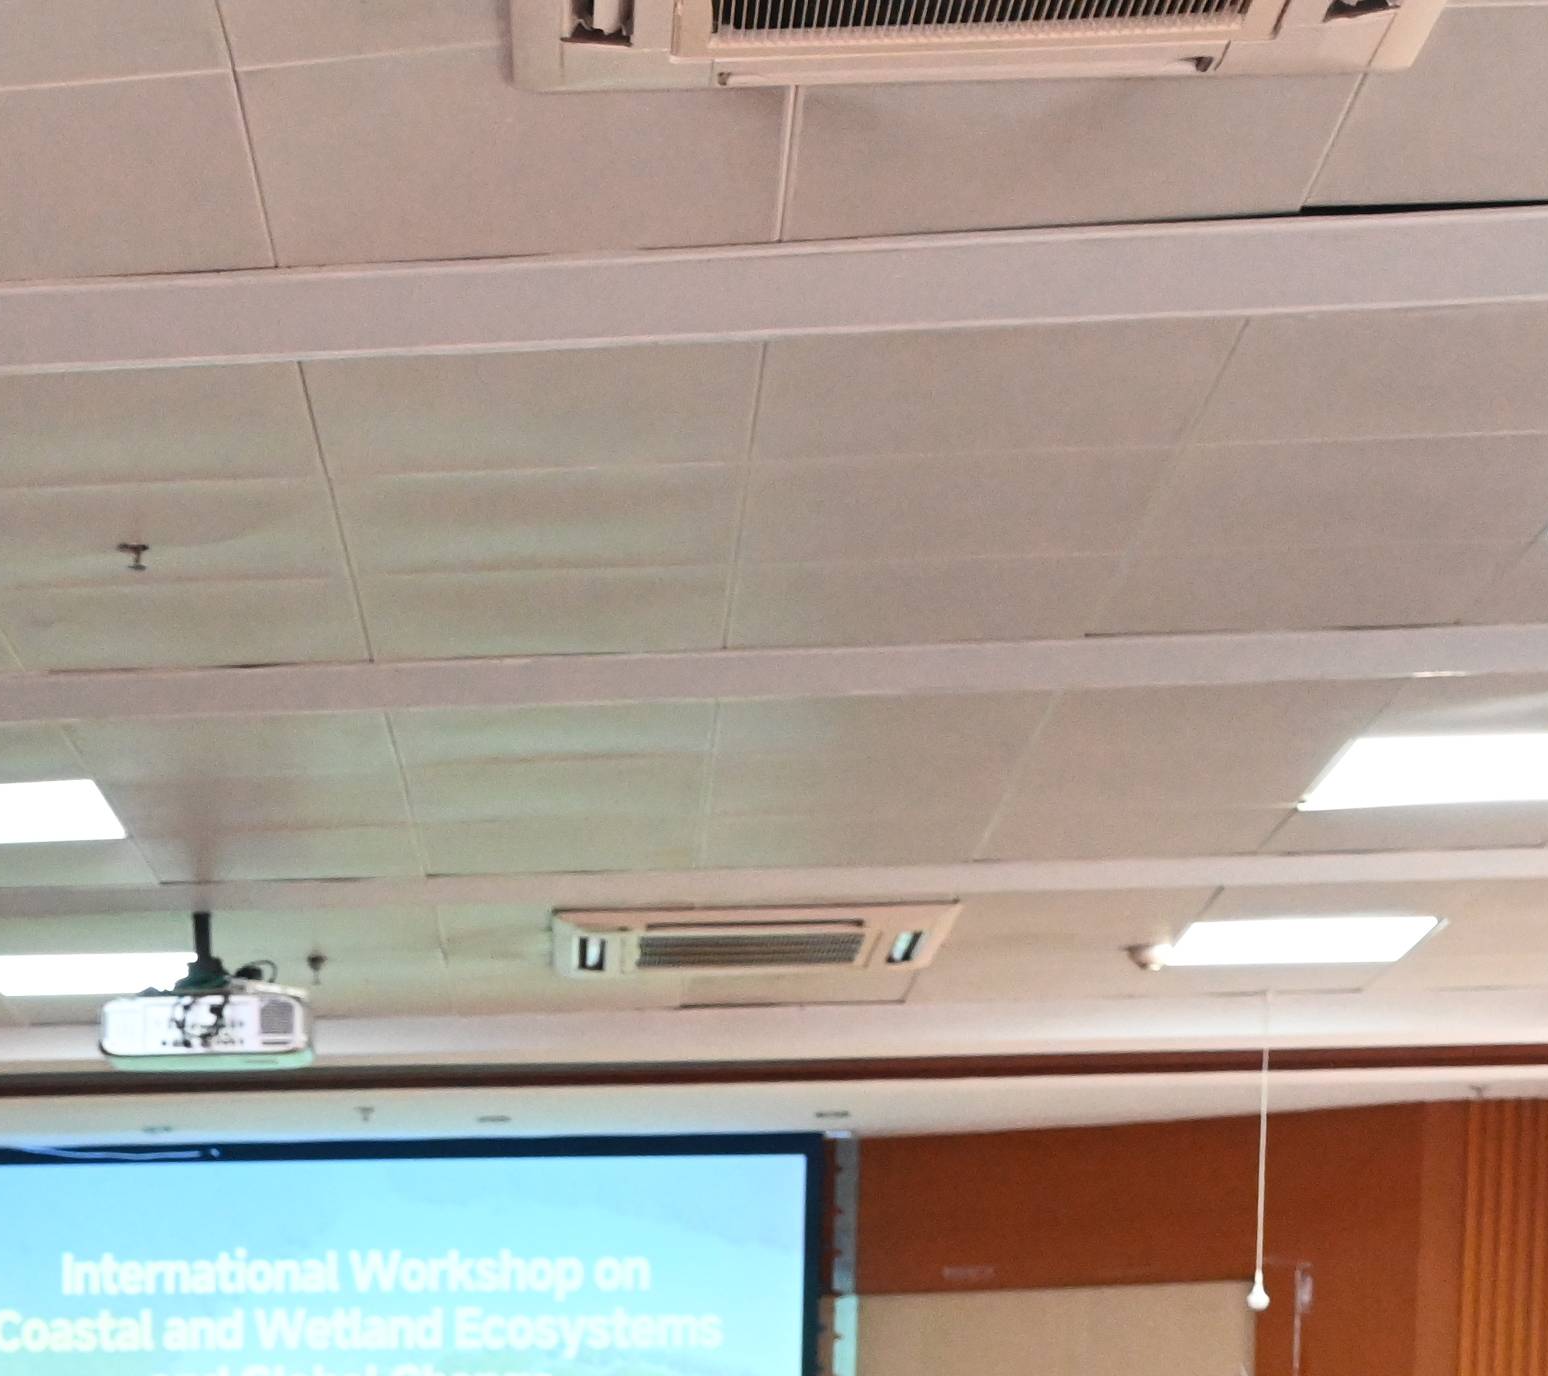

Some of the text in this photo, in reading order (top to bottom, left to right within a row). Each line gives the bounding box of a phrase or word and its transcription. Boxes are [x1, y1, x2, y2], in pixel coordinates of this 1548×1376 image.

[61, 1249, 652, 1301] International Workshop on
[163, 1309, 242, 1350] and
[255, 1307, 443, 1350] Wetland
[454, 1307, 724, 1359] Ecosystems
